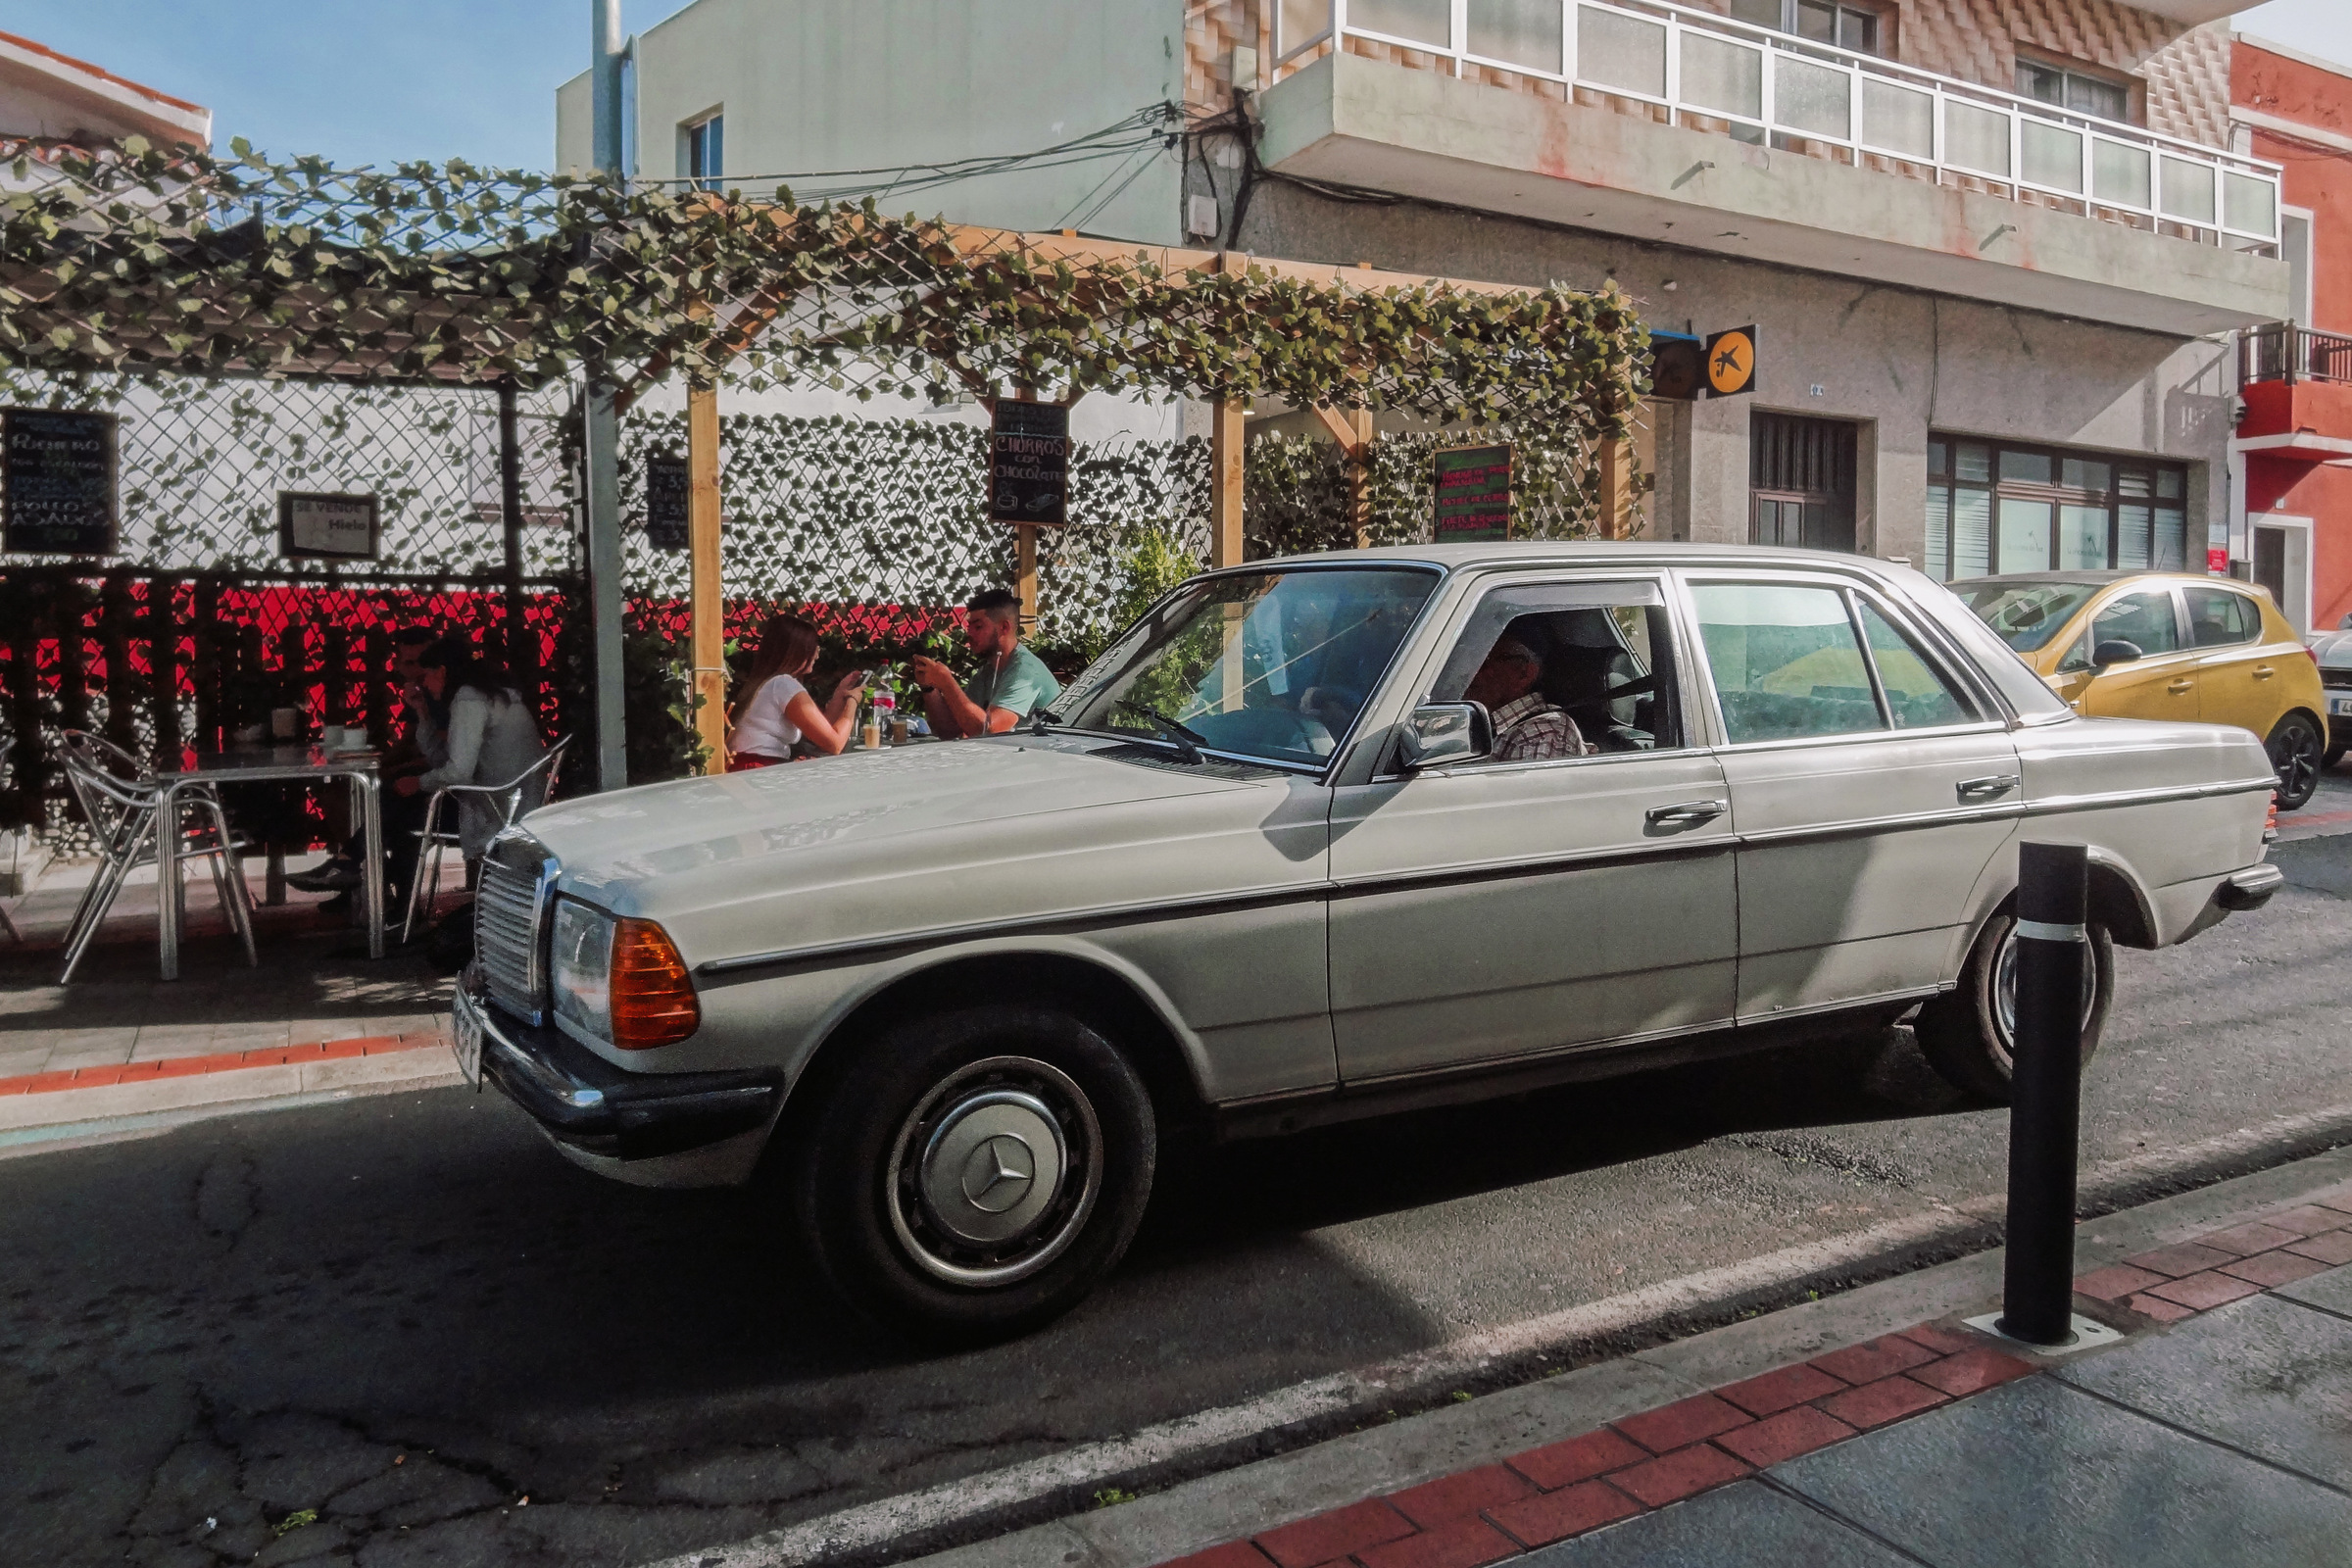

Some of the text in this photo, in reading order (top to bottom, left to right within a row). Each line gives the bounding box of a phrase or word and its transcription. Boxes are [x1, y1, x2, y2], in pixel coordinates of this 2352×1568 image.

[995, 436, 1064, 457] CHURROS
[316, 502, 362, 514] VENDE
[328, 518, 367, 531] Hielo
